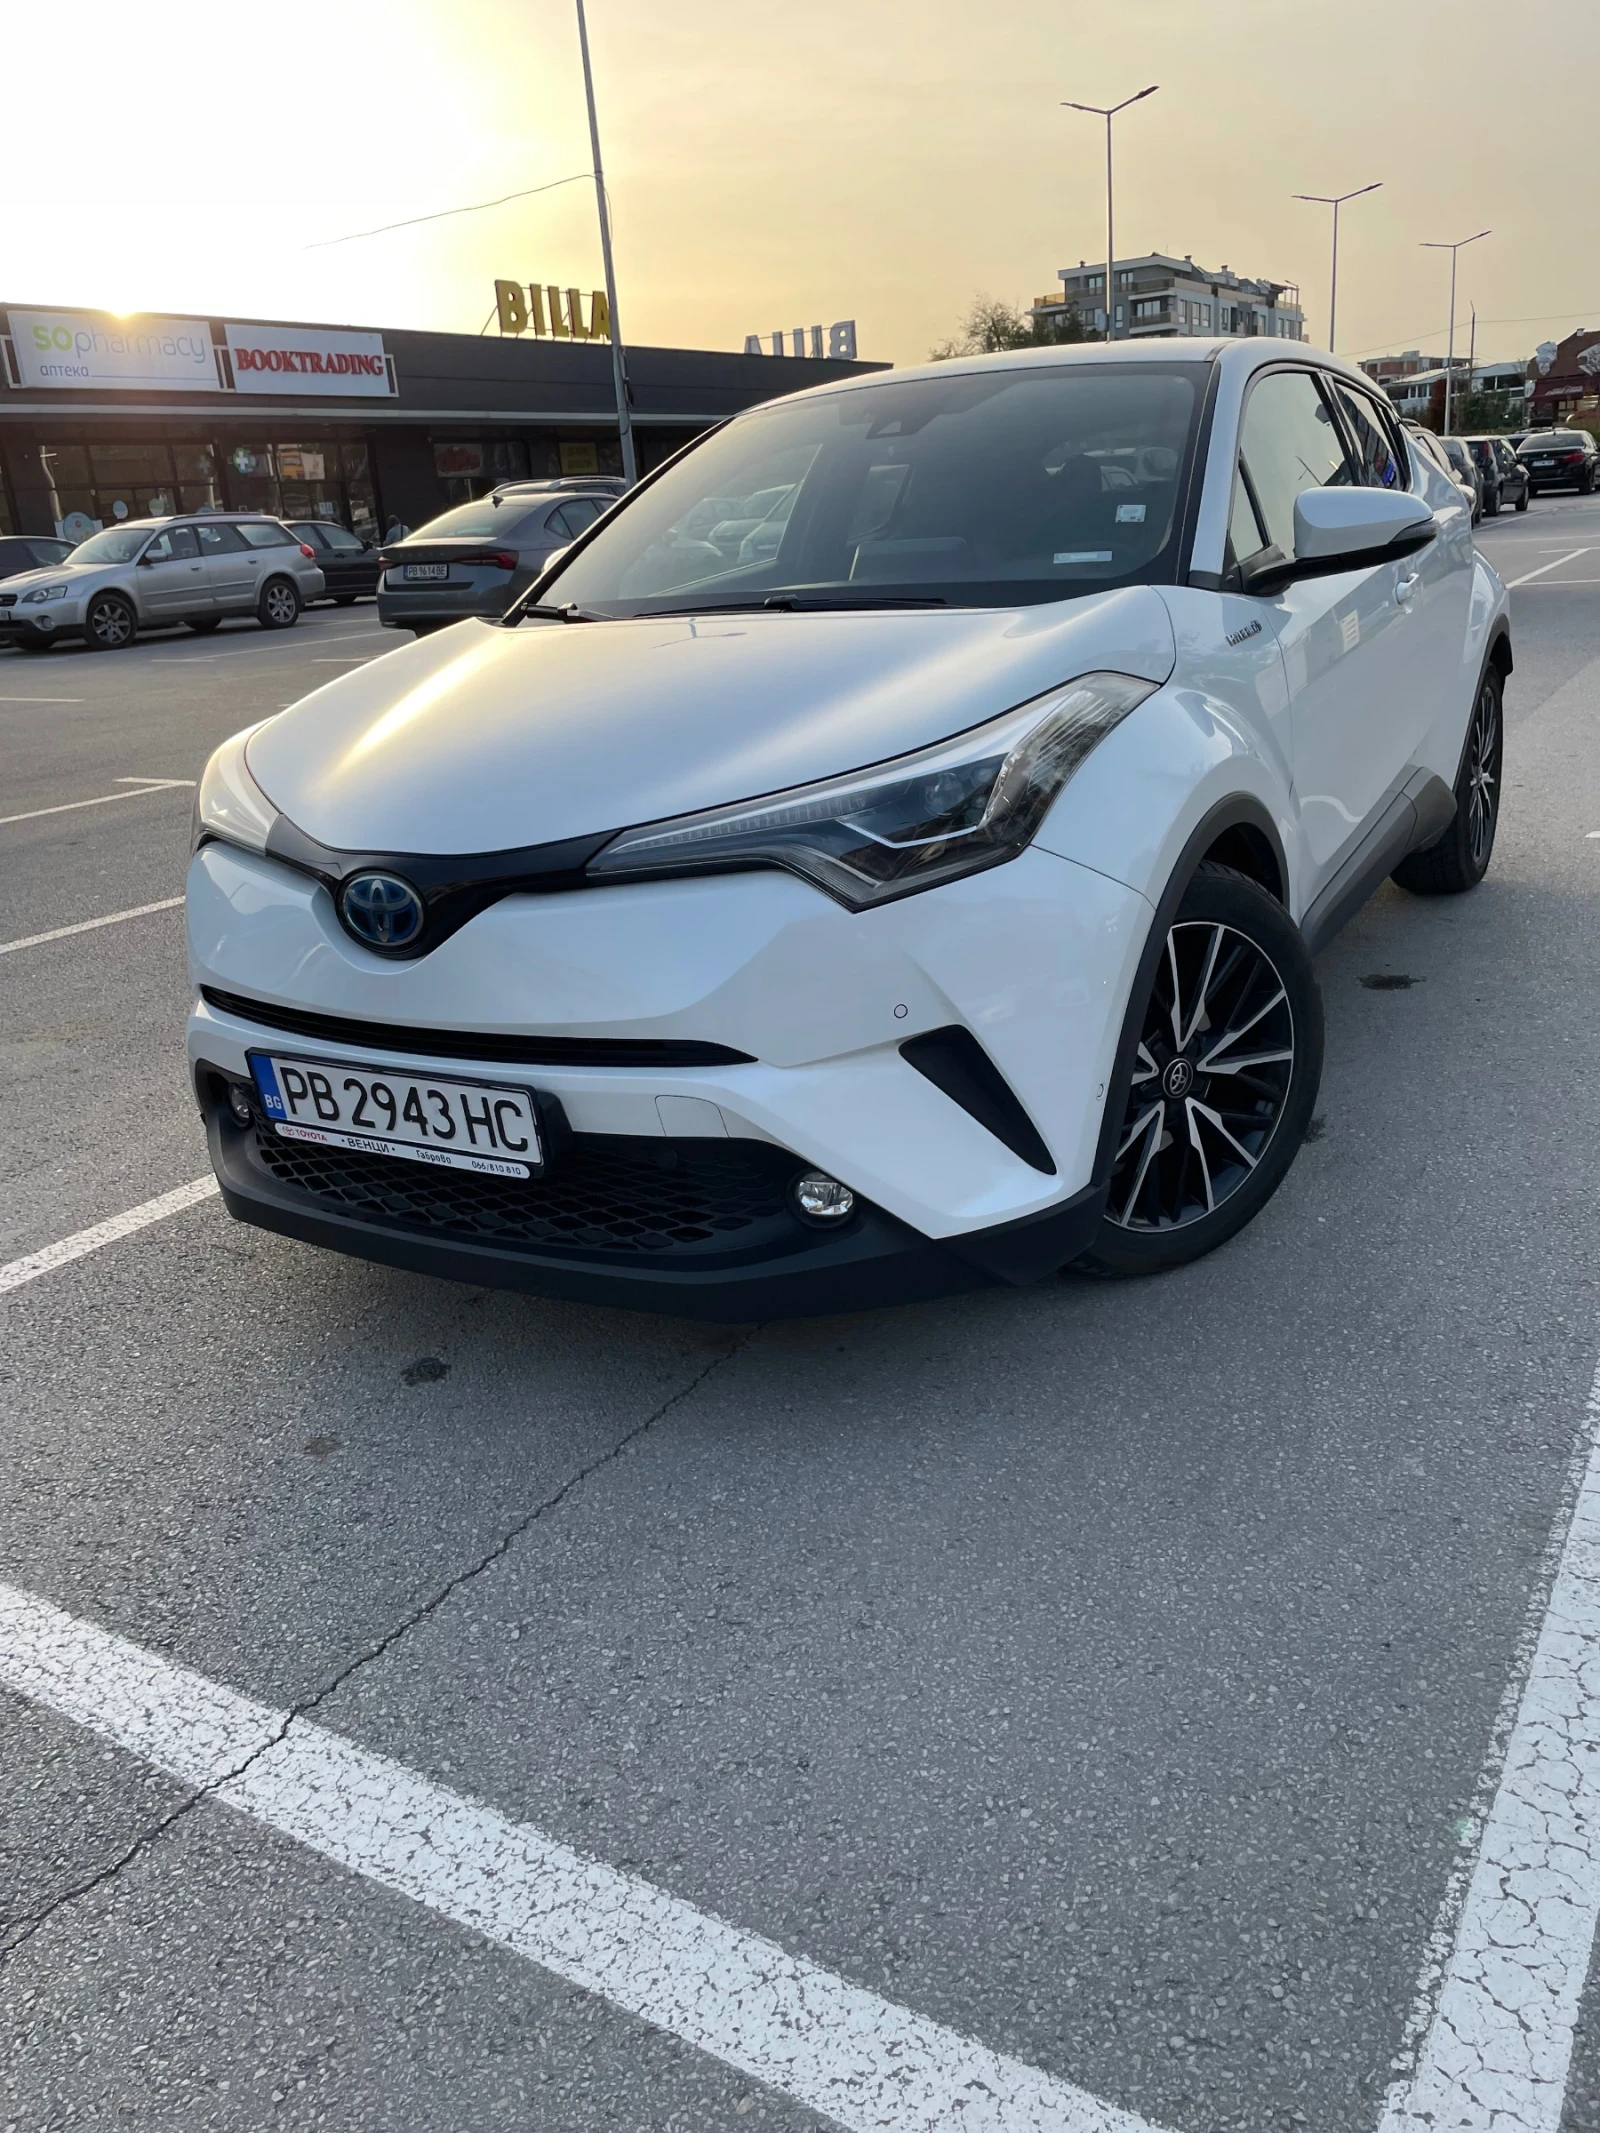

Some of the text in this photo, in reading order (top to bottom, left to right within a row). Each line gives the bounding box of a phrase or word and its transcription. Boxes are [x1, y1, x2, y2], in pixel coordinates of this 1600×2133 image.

[494, 280, 611, 340] BILLA
[33, 325, 206, 363] sopharmacy
[40, 364, 89, 377] аптека
[235, 349, 384, 375] BOOKTRADING
[265, 1094, 283, 1110] BG
[295, 1129, 328, 1141] TOYOTA
